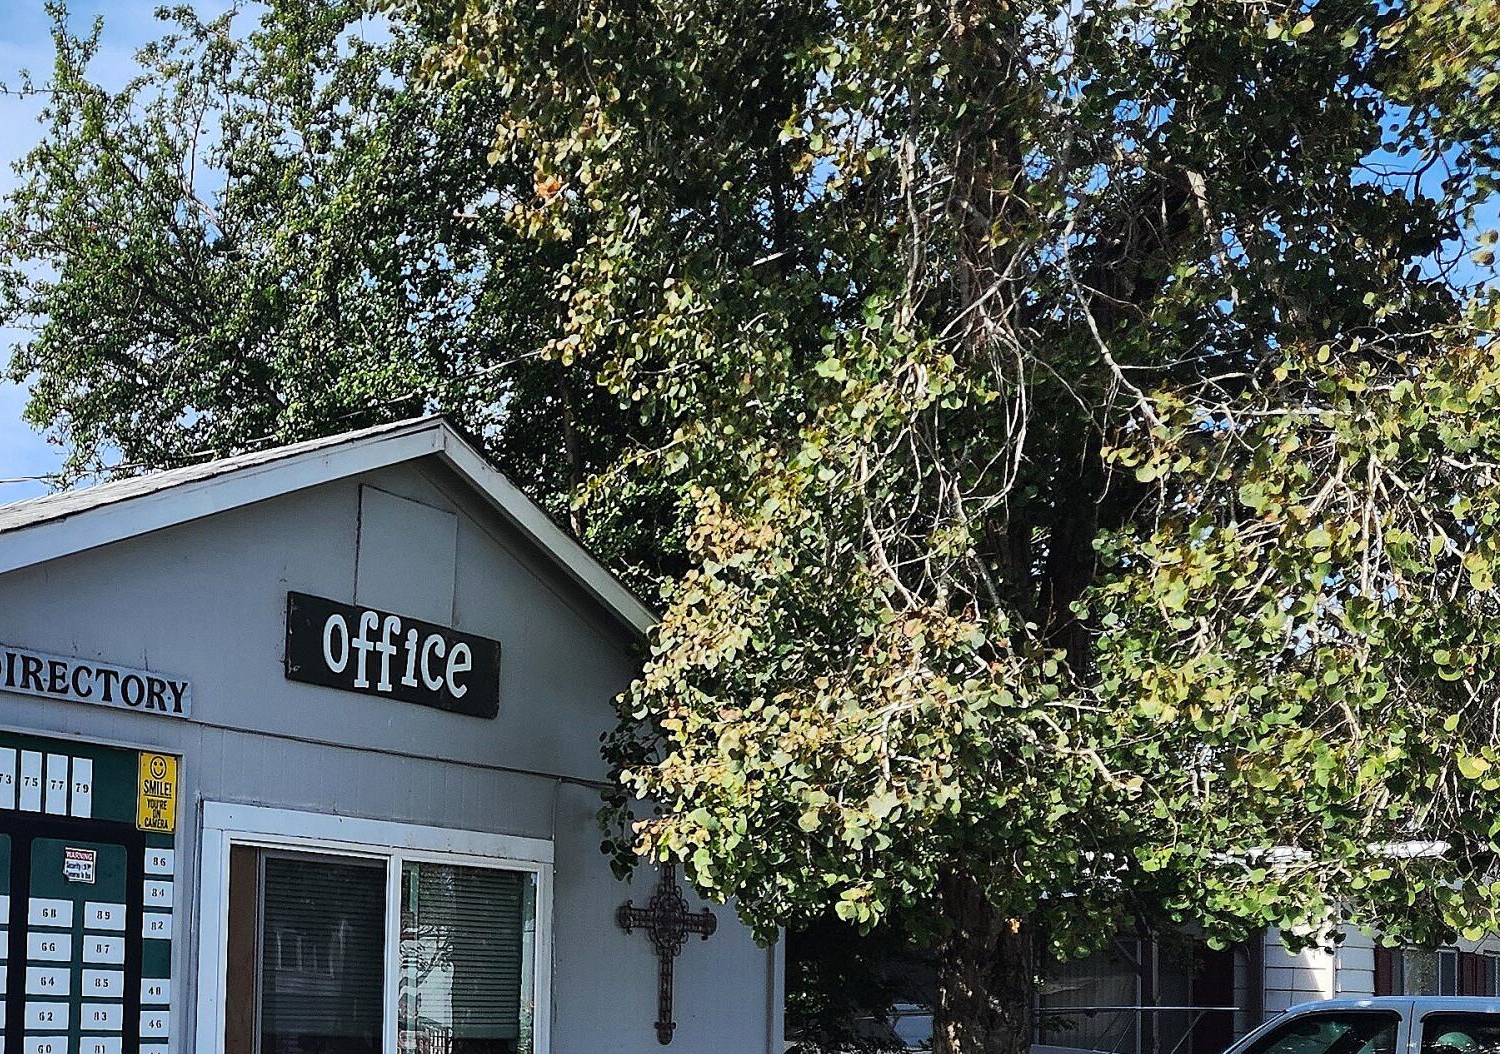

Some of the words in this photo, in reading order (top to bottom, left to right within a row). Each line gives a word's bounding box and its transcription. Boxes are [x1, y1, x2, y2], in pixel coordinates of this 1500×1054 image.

[323, 611, 472, 698] Office
[24, 776, 39, 787] 75
[50, 779, 65, 791] 77
[75, 782, 90, 794] 79
[144, 779, 172, 797] SMILE!
[144, 817, 168, 829] CAMERA
[152, 856, 166, 867] 86
[151, 888, 165, 897] 84
[42, 907, 57, 919] 68
[96, 910, 111, 920] 89
[150, 920, 164, 931] 82
[41, 942, 56, 952] 66
[95, 943, 110, 954] 87
[40, 976, 55, 987] 64
[94, 978, 109, 988] 85
[148, 986, 161, 996] 48
[38, 1011, 53, 1022] 62
[148, 1019, 162, 1029] 46
